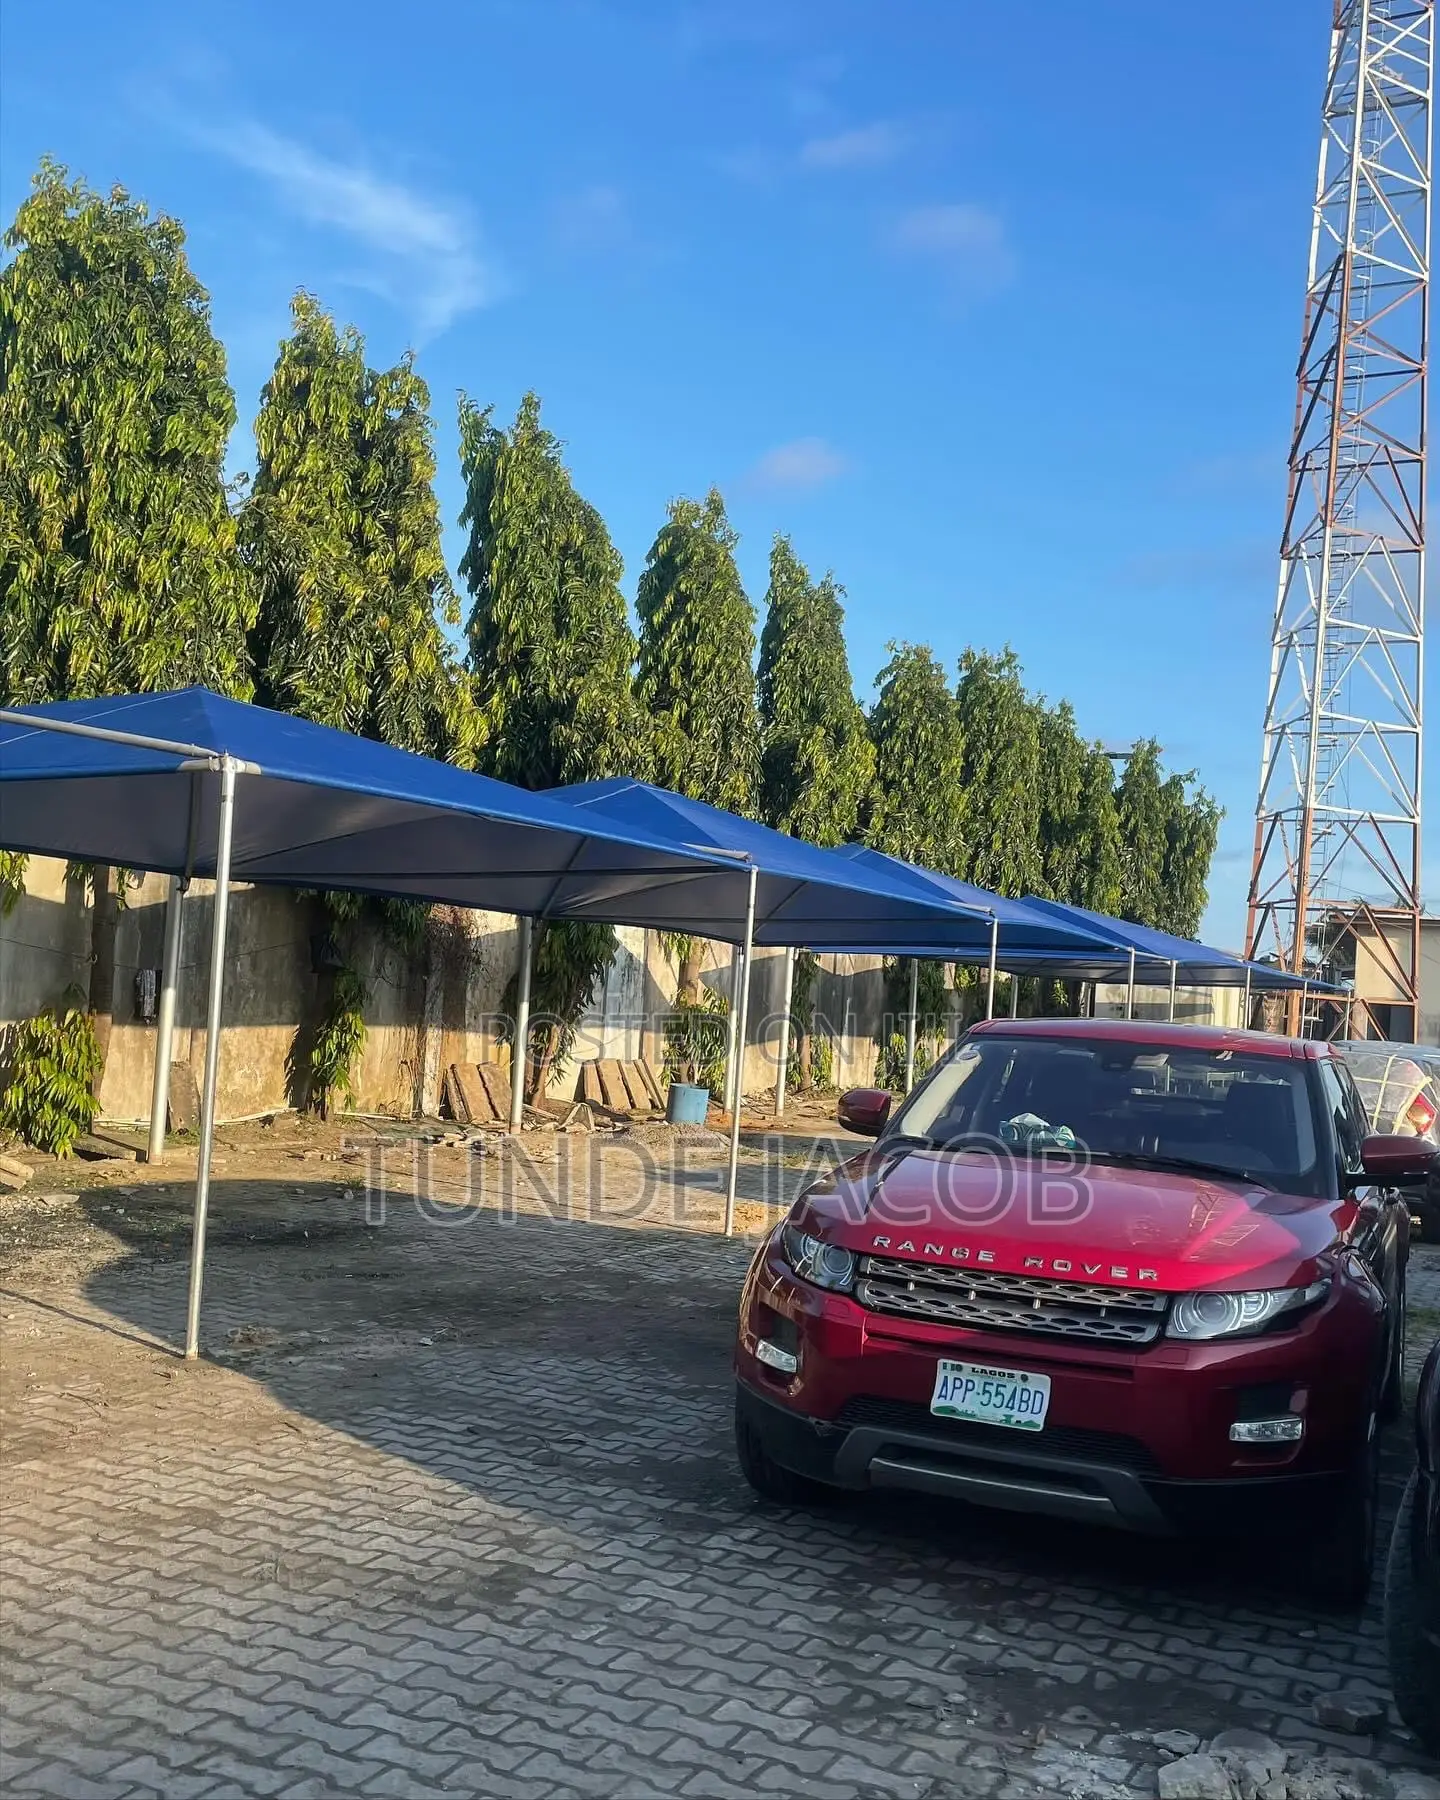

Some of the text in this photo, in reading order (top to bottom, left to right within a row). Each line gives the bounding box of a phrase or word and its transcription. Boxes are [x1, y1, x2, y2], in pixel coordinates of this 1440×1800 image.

[873, 1235, 1158, 1281] RANGE ROVER
[971, 1367, 1016, 1379] LAGOS
